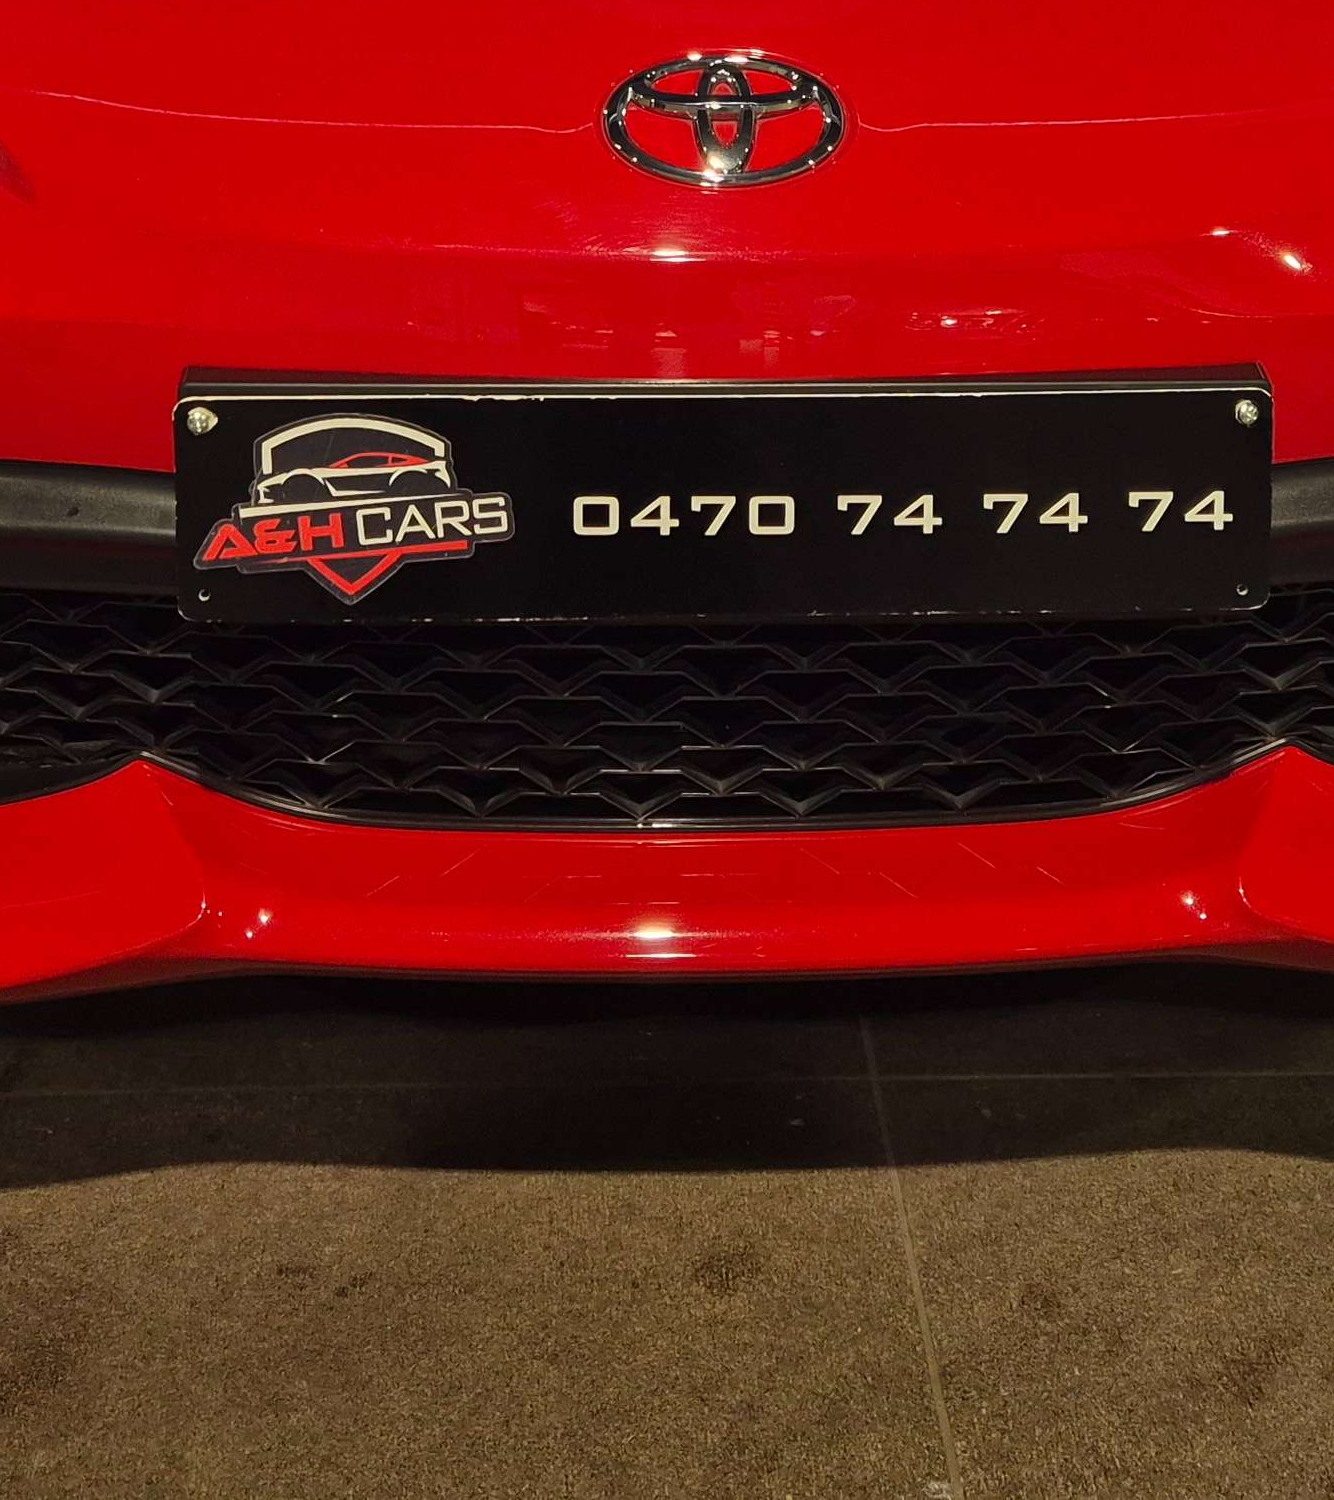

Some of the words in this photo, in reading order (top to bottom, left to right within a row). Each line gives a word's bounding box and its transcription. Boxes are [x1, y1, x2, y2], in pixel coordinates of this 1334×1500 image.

[203, 512, 345, 561] A&H
[356, 496, 508, 546] CARS
[573, 495, 795, 536] 0470
[837, 494, 943, 535] 74
[983, 492, 1089, 534] 74
[1128, 490, 1234, 532] 74
